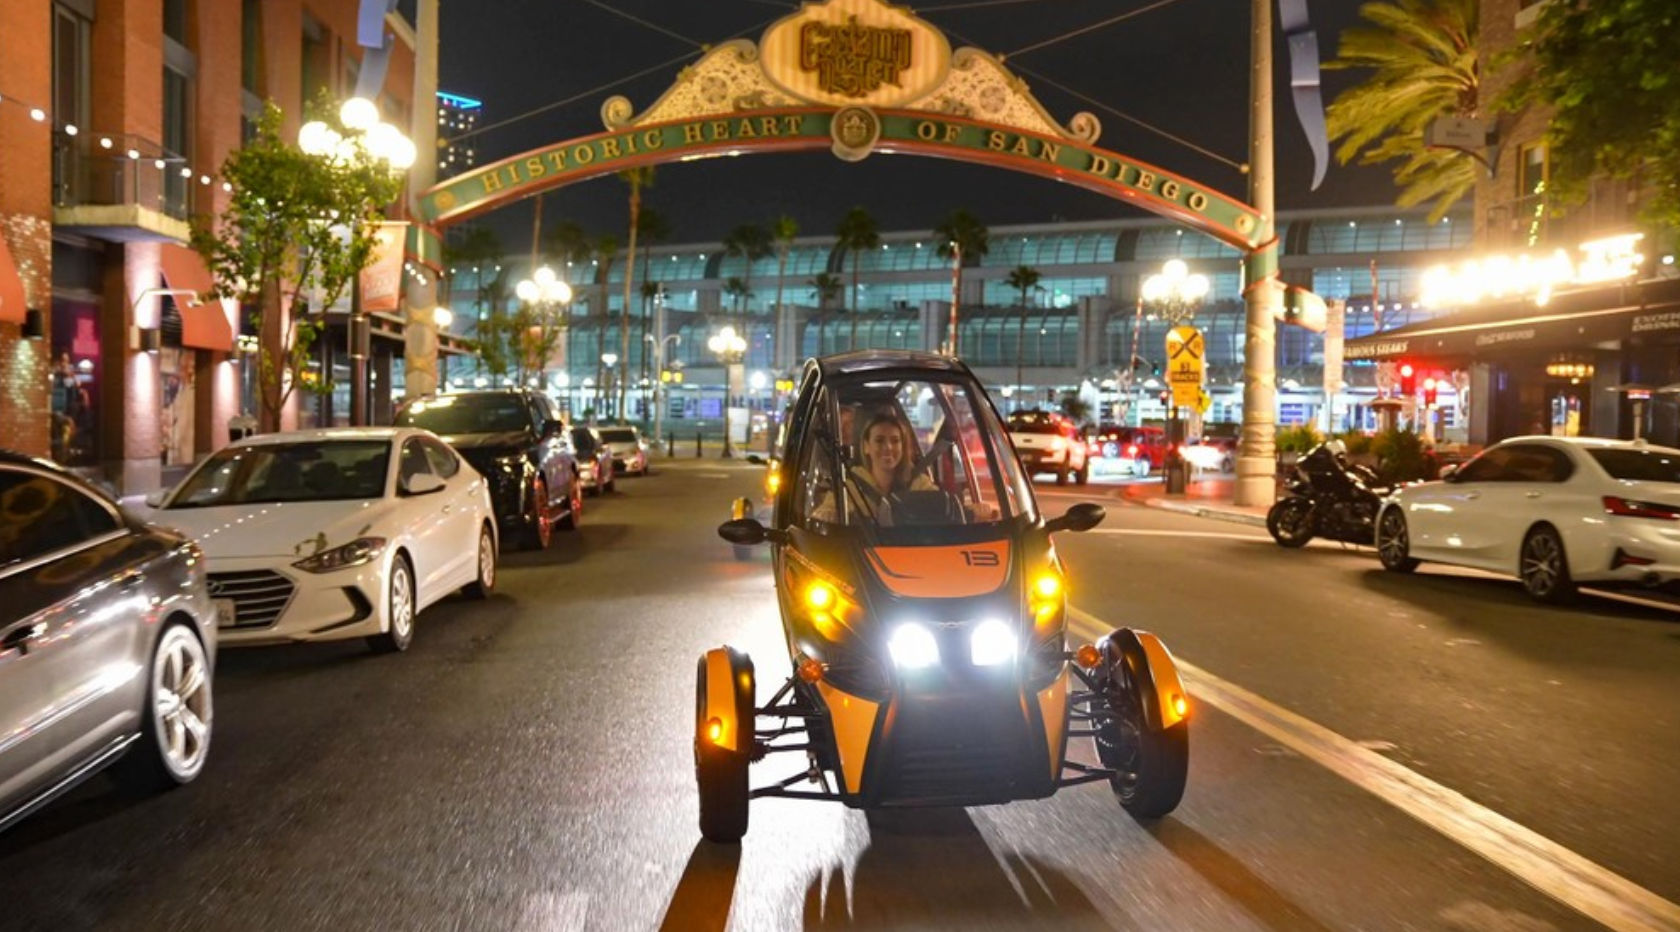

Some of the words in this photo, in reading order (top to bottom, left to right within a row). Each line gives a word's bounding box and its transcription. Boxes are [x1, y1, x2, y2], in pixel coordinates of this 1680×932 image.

[481, 128, 664, 194] HISTORIC
[684, 115, 804, 144] HEART
[917, 121, 962, 143] OF
[988, 131, 1061, 162] SAN
[1088, 154, 1208, 212] DIEGO
[960, 550, 999, 567] 13
